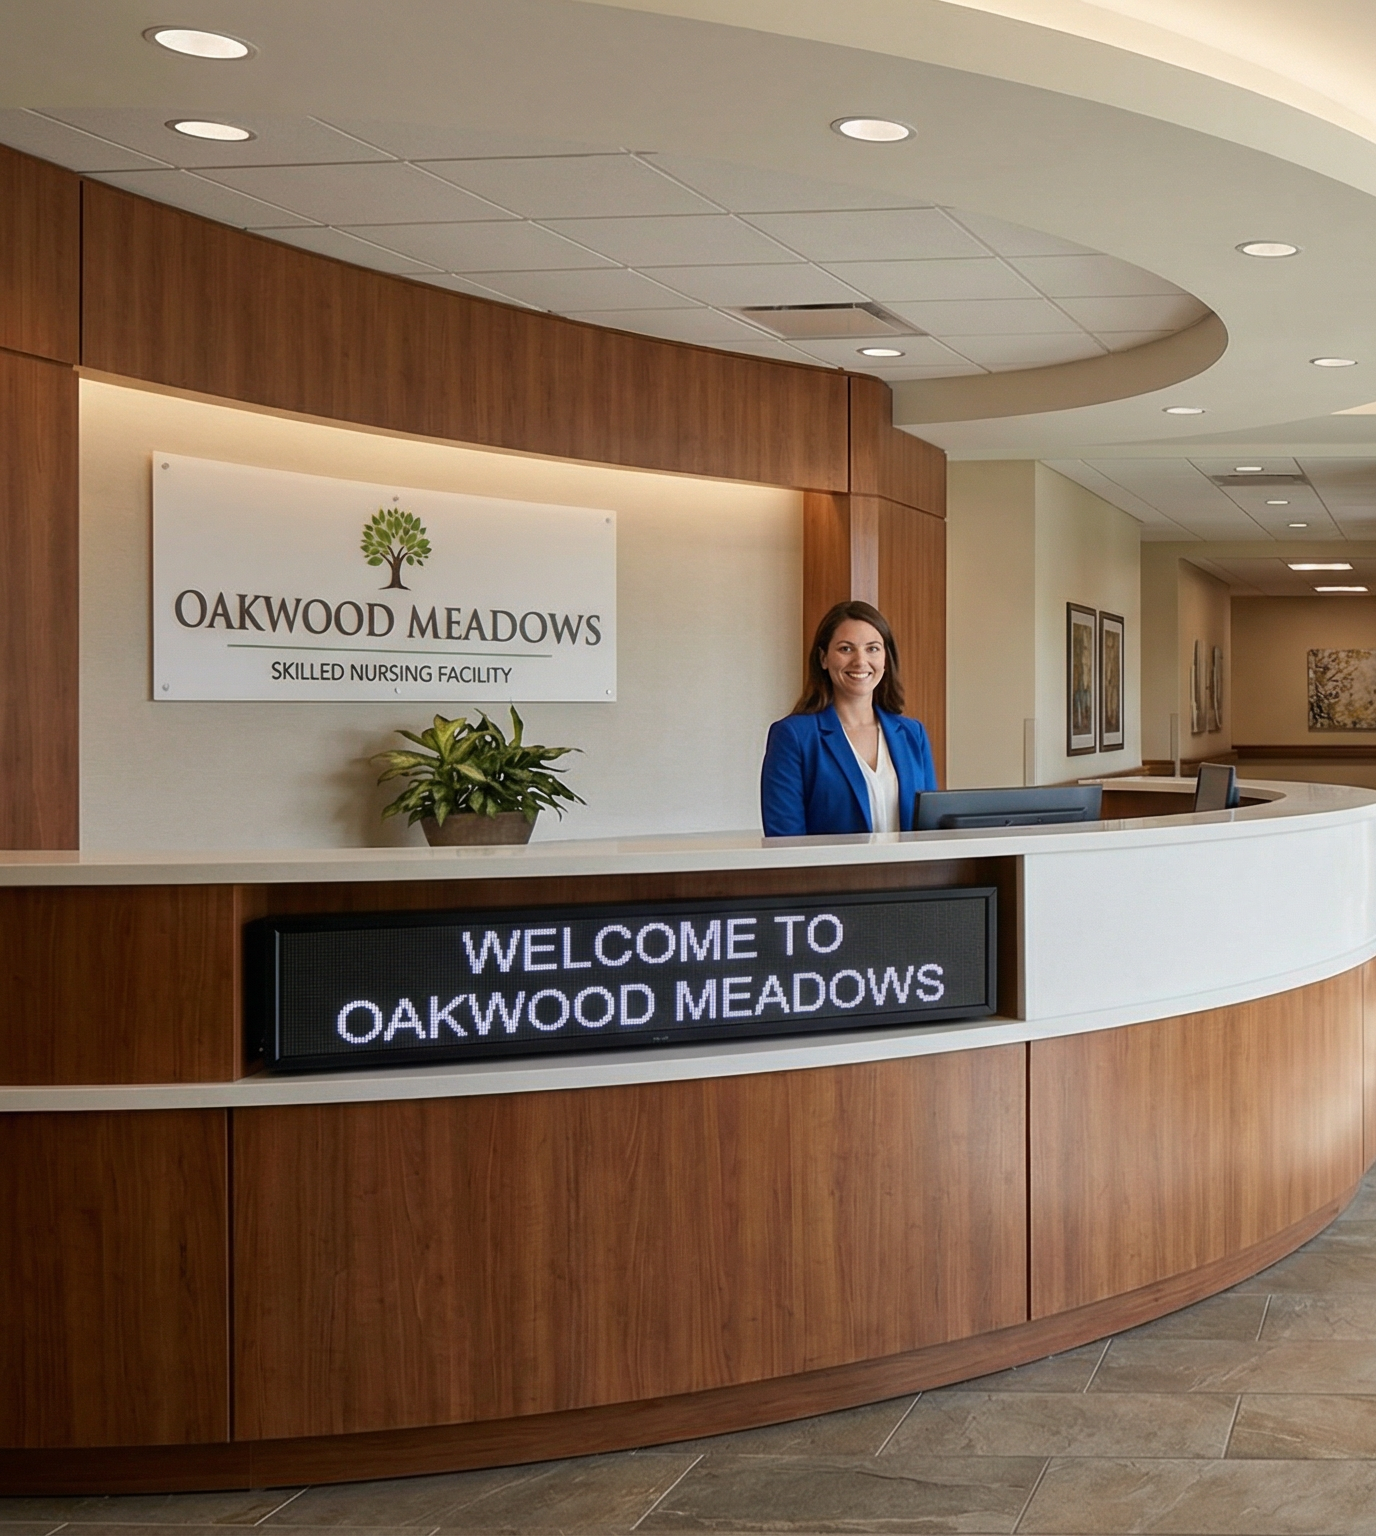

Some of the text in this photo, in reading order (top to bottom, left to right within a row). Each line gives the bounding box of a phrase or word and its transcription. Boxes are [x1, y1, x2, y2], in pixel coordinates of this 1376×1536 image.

[174, 589, 602, 646] OAKWOOD MEADOWS
[271, 661, 513, 684] SKILLED NURSING FACILITY
[462, 913, 844, 975] WELCOME TO
[336, 963, 945, 1044] OAKWOOD MEADOWS
